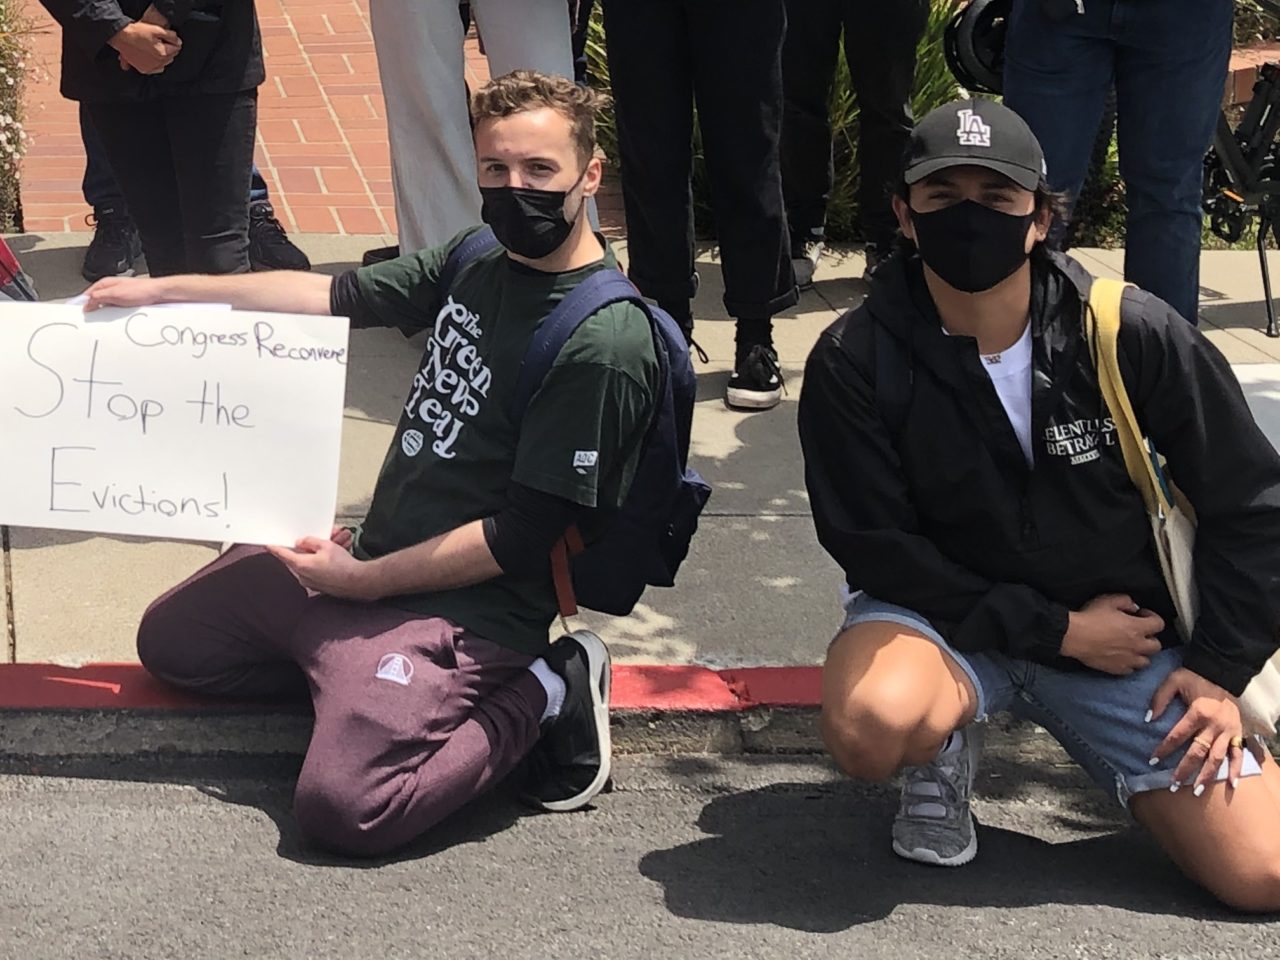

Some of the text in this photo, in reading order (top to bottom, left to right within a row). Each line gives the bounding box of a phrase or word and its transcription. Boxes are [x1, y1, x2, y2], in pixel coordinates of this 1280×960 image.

[956, 109, 991, 147] LA
[125, 312, 348, 366] Congress Reconvene
[14, 322, 256, 435] Stop the
[49, 446, 231, 529] Evictions!
